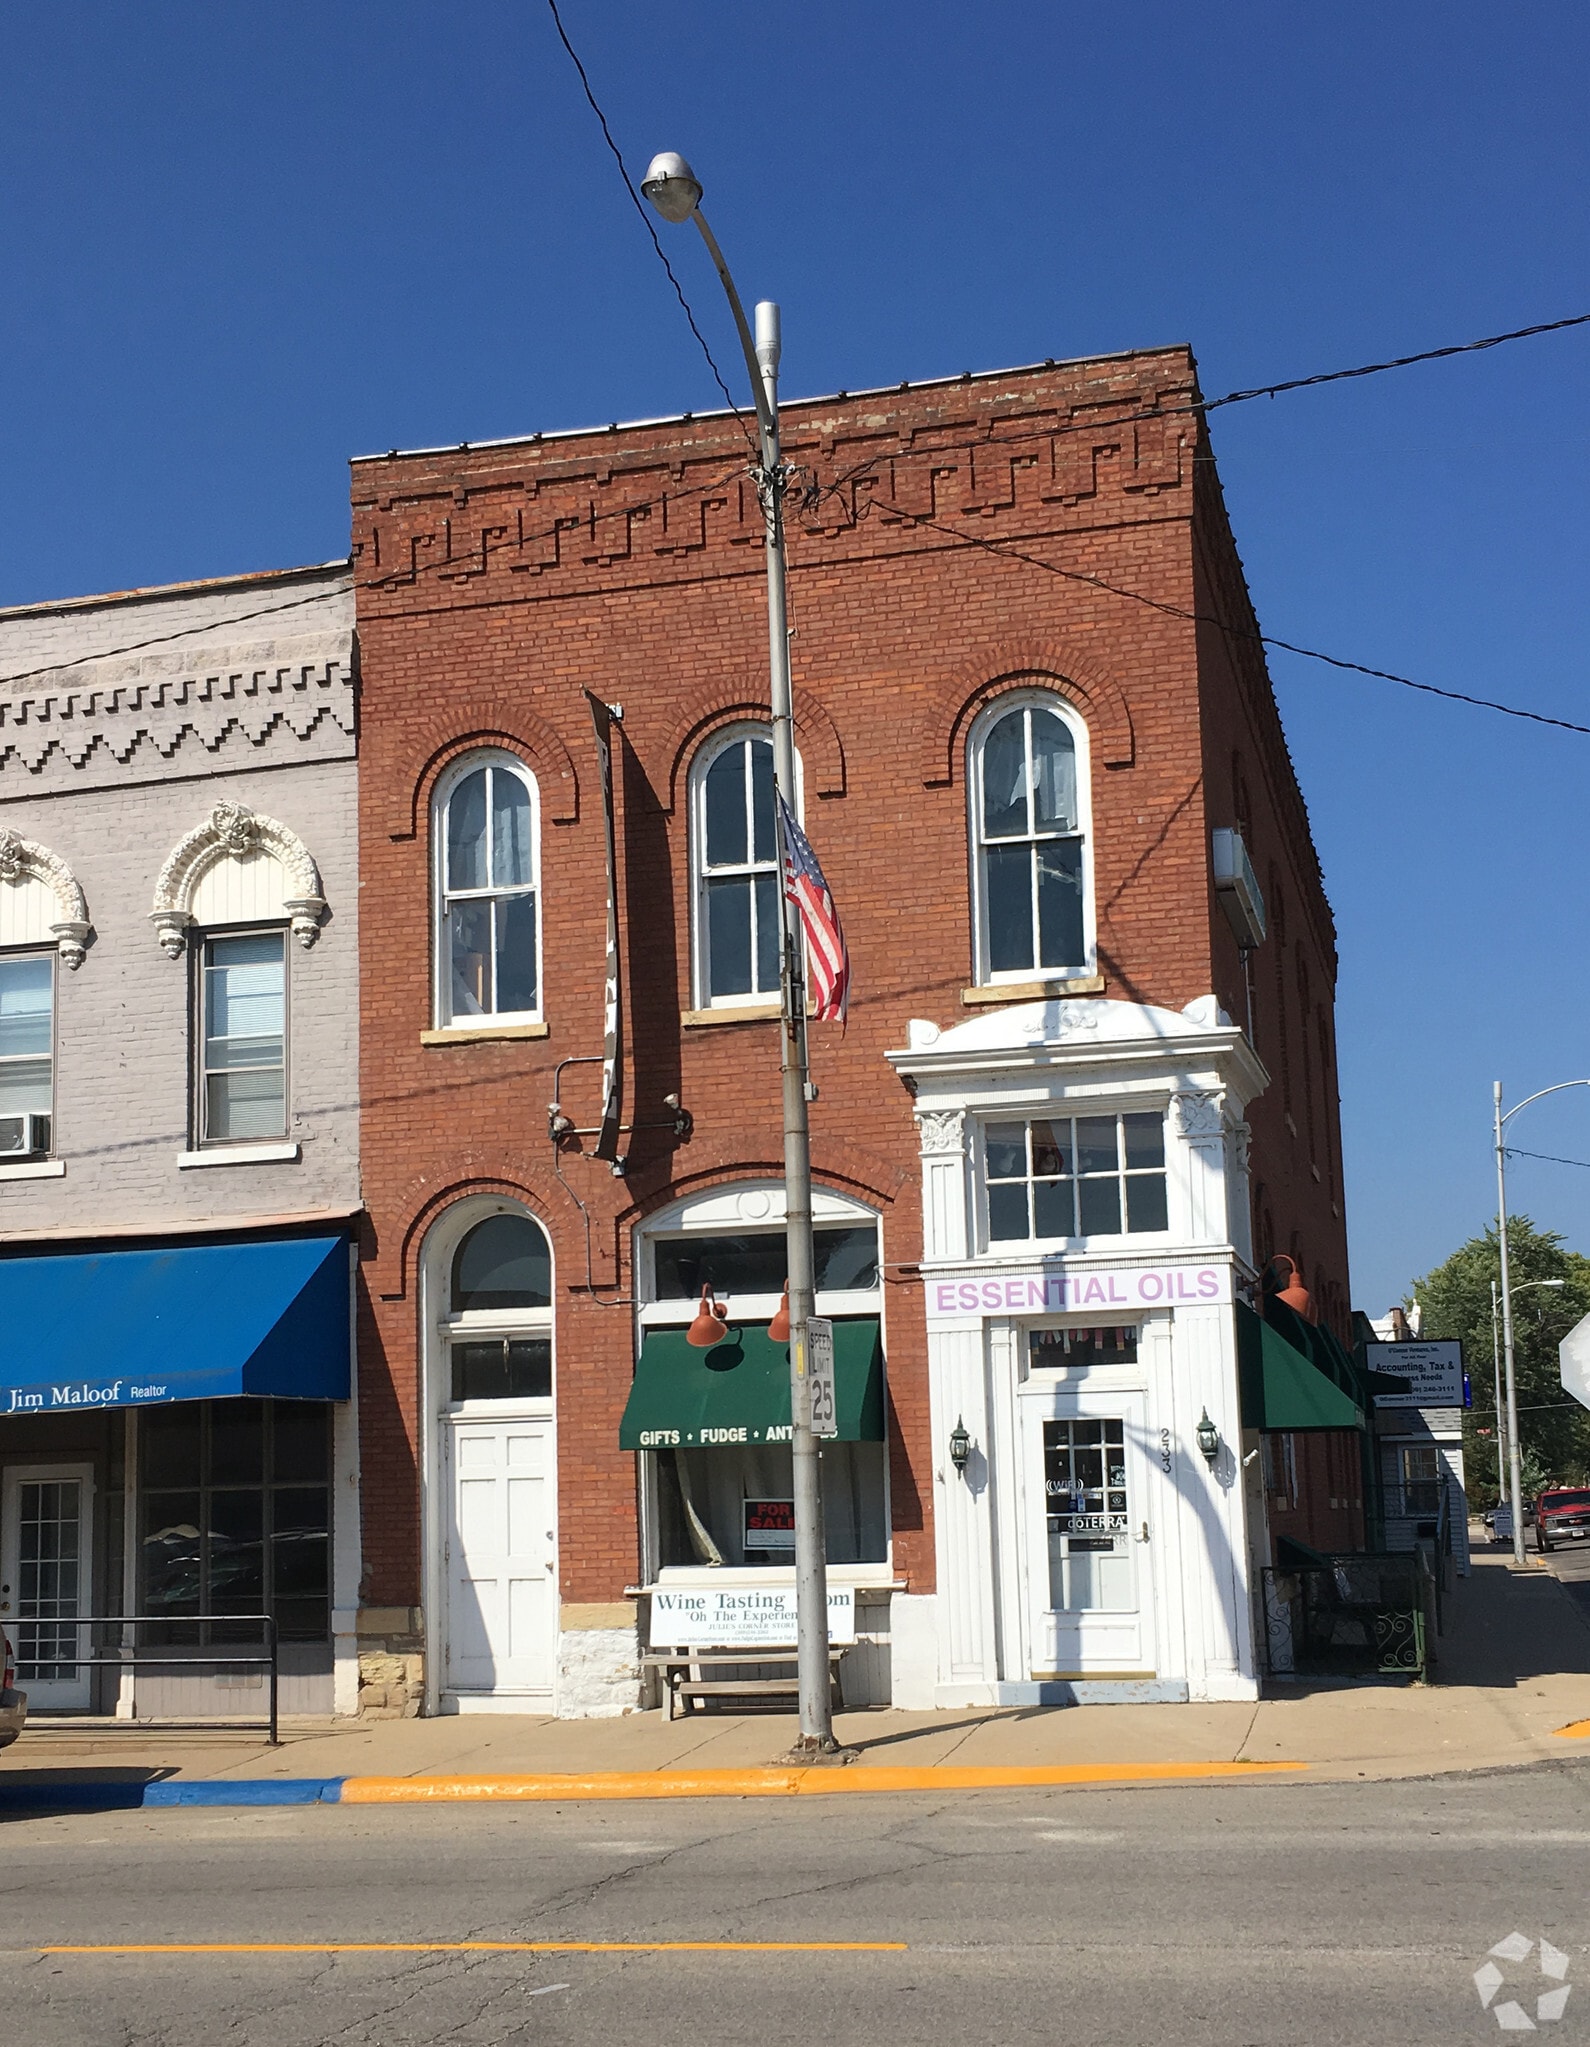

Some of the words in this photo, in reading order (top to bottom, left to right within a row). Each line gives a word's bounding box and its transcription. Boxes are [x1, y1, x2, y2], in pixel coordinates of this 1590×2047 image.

[937, 1276, 1127, 1311] ESSENTIAL
[1138, 1270, 1220, 1301] OILS
[810, 1332, 832, 1350] SPEED
[1376, 1362, 1427, 1372] Accounting,
[1429, 1361, 1445, 1371] Tax
[1447, 1360, 1455, 1370] &
[7, 1389, 43, 1413] Jim
[51, 1380, 122, 1405] Maloof
[130, 1386, 167, 1398] Realtor
[812, 1380, 833, 1420] 25
[639, 1429, 680, 1445] GIFTS
[700, 1427, 748, 1443] FUDGE
[1161, 1428, 1172, 1473] 233
[756, 1503, 790, 1516] FOR
[749, 1516, 795, 1529] SALE
[657, 1594, 706, 1610] Wine
[715, 1591, 786, 1611] Tasting
[713, 1611, 737, 1622] The
[743, 1610, 798, 1624] Experien
